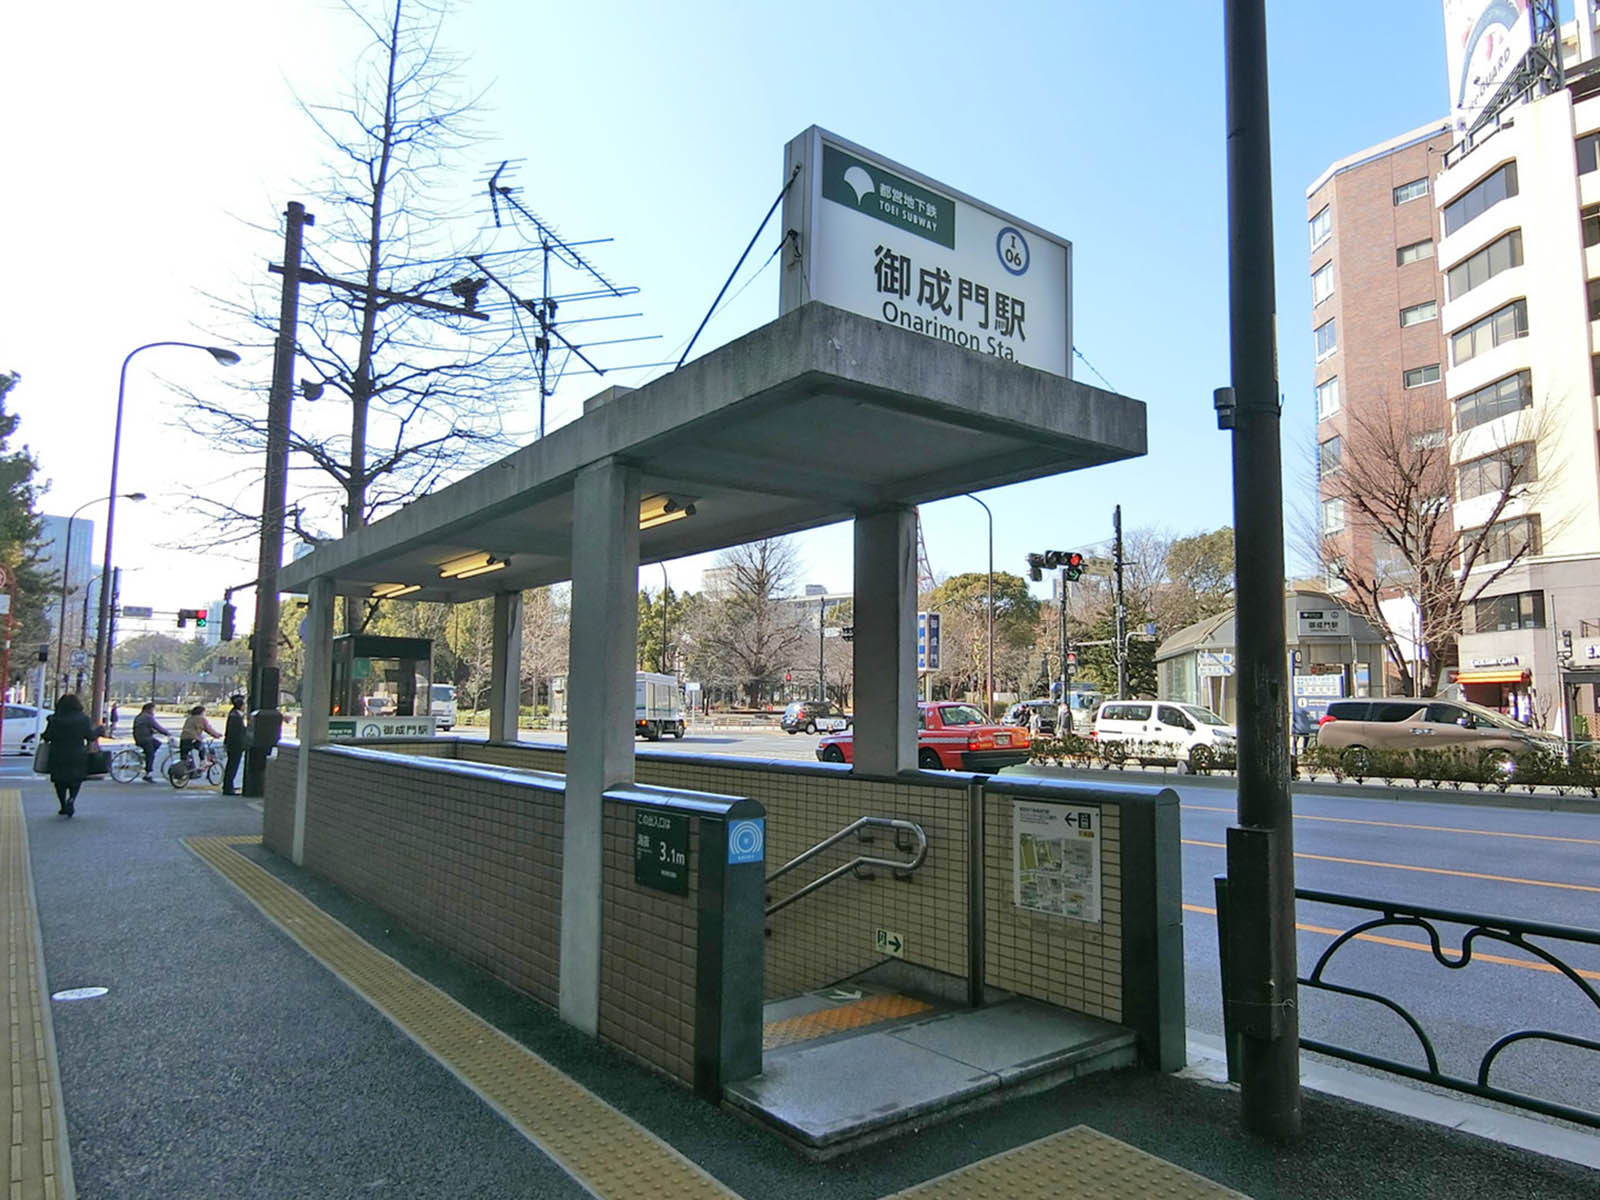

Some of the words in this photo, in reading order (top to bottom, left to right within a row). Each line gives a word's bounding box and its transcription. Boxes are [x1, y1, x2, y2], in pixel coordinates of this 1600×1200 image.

[879, 183, 938, 219] 都営地下鉄
[879, 199, 899, 216] TOEI
[902, 209, 938, 233] SUBWAY
[1004, 248, 1022, 267] 06
[1010, 235, 1017, 249] I
[874, 244, 1026, 342] 御成門駅
[882, 300, 981, 350] Onarimon
[986, 336, 1019, 363] Sta.
[659, 841, 686, 866] 3.1m
